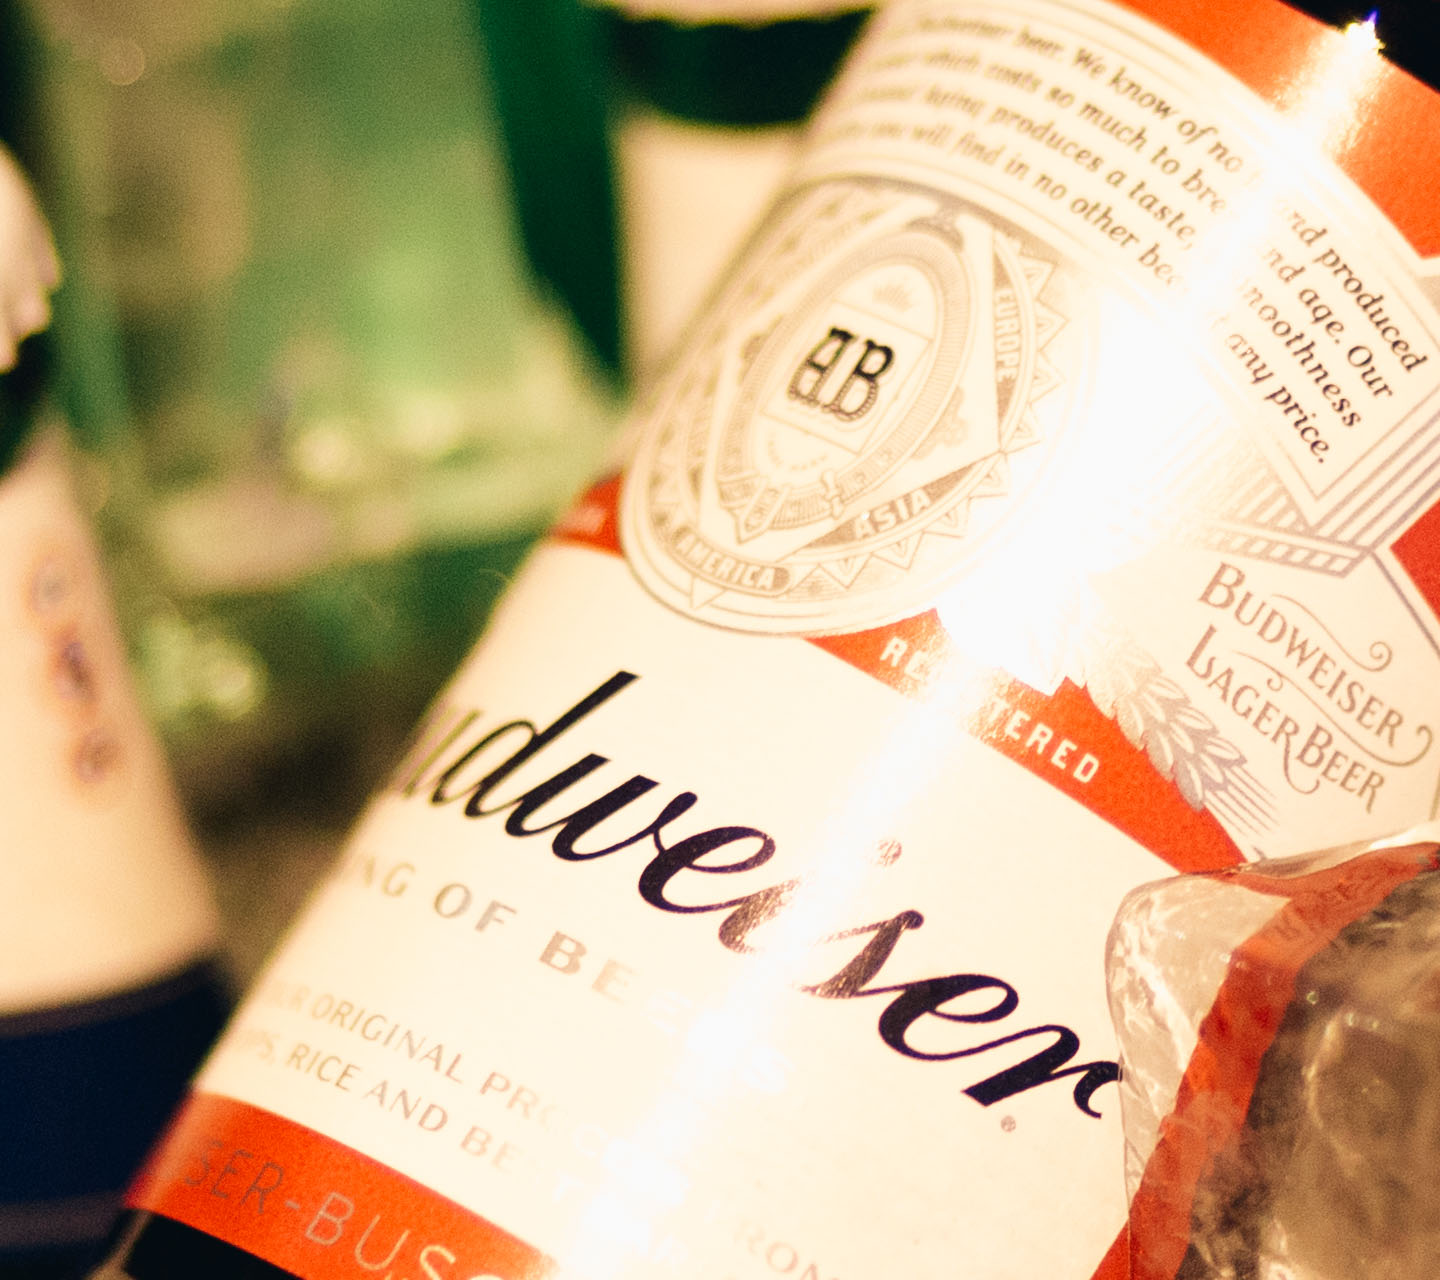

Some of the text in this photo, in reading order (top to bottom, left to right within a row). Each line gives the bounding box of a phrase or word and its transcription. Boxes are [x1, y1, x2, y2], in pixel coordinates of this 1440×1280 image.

[989, 104, 1105, 173] produces
[1106, 169, 1127, 189] a
[1127, 180, 1197, 250] taste,
[1238, 280, 1361, 428] moothness
[1046, 85, 1076, 110] so
[1079, 101, 1148, 153] much
[1150, 145, 1180, 176] to
[1180, 168, 1230, 217] bre
[1296, 286, 1346, 345] age.
[1346, 344, 1393, 400] Our
[1071, 47, 1105, 78] We
[1110, 67, 1178, 120] know
[1177, 118, 1219, 146] of
[1206, 141, 1244, 173] no
[1314, 247, 1428, 372] produced
[953, 130, 1004, 168] find
[1004, 152, 1031, 181] in
[1033, 172, 1067, 202] no
[1070, 194, 1140, 250] other
[1224, 331, 1274, 384] any
[1263, 384, 1332, 464] price.
[993, 286, 1024, 384] EUROPE
[673, 526, 778, 592] AMERICA
[857, 488, 933, 540] ASIA
[878, 636, 1102, 784] RETERED
[1196, 559, 1408, 750] BUDWEISER
[402, 669, 1125, 1121] udweiser
[432, 880, 517, 934] OF
[286, 1041, 362, 1093] RICE
[361, 1077, 450, 1134] AND
[311, 991, 466, 1086] ORIGINAL
